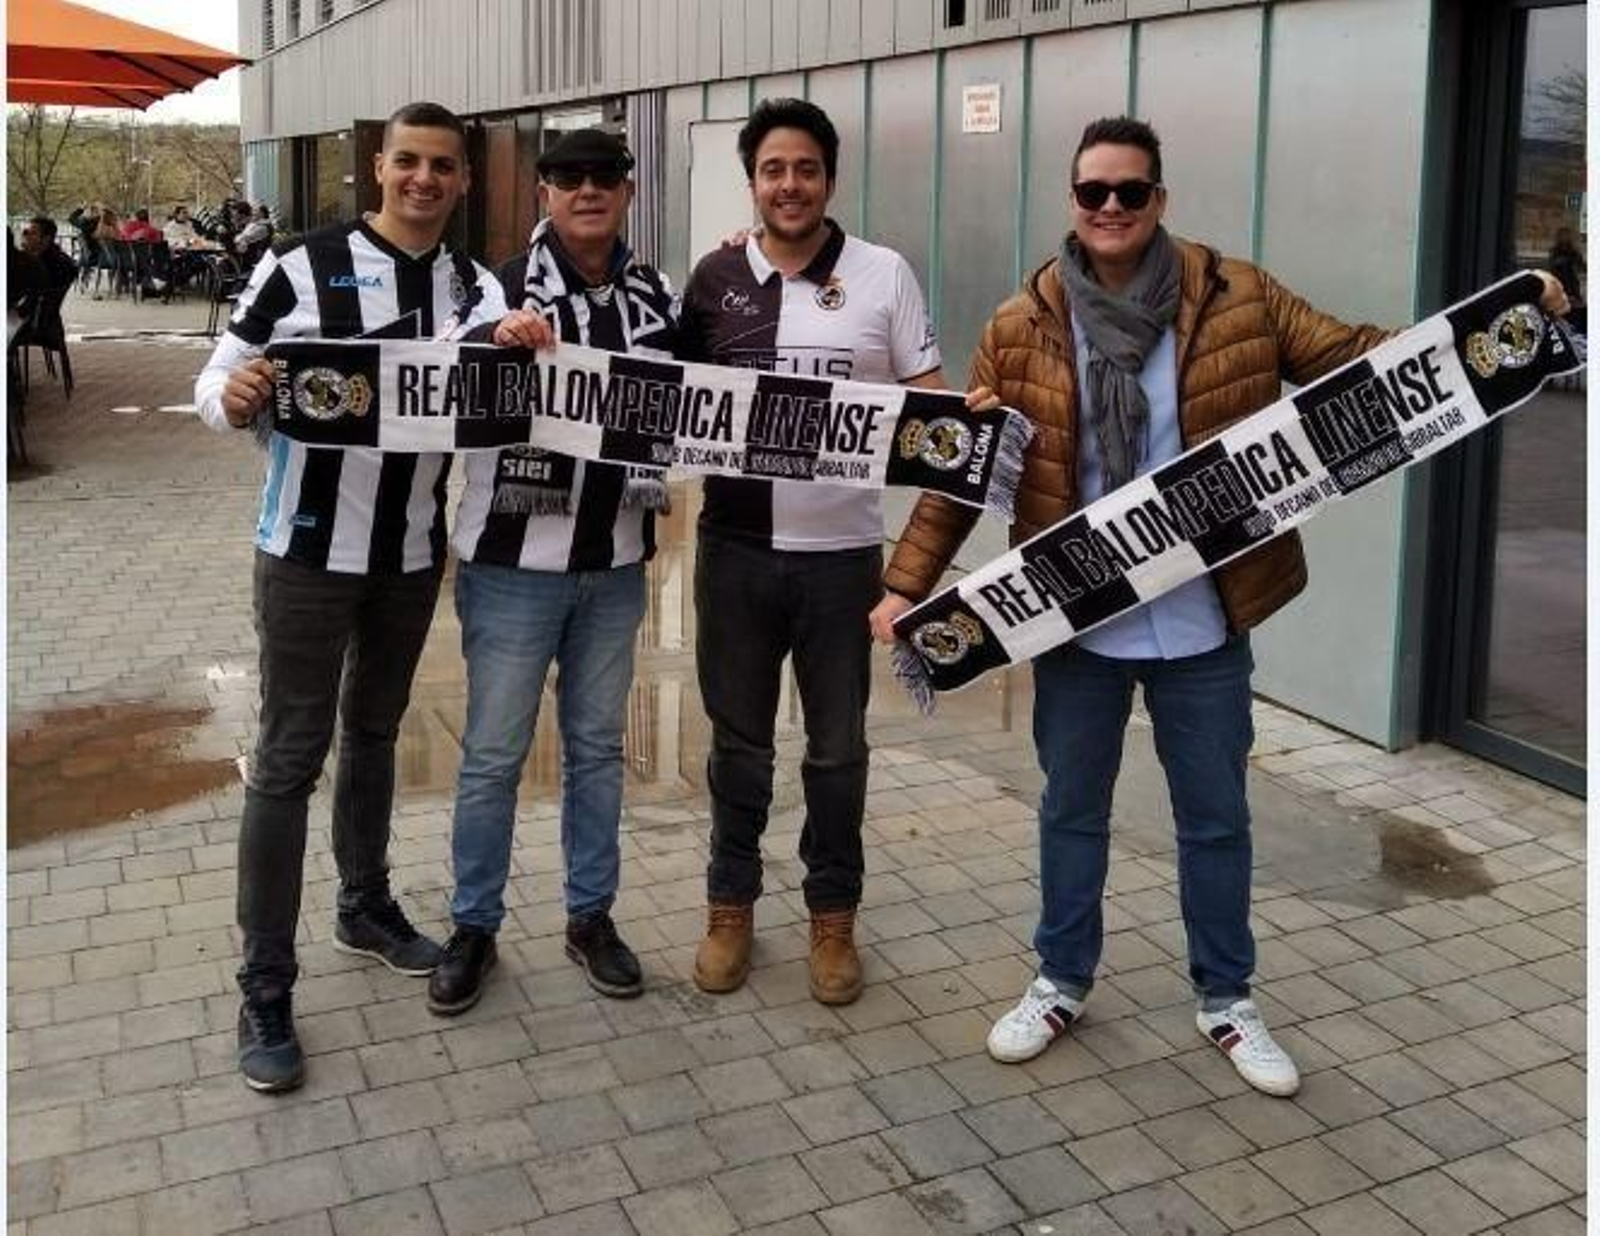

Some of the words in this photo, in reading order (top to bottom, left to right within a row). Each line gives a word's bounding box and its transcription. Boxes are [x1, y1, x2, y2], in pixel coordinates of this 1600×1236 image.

[273, 360, 292, 420] BALONA
[397, 362, 487, 419] REAL
[495, 362, 734, 443] BALOMPEDICA
[744, 391, 885, 455] LINENSE
[966, 423, 994, 485] BALONA
[977, 555, 1085, 629] REAL
[1062, 430, 1311, 591] BALOMPEDICA
[1299, 345, 1454, 467] LINENSE
